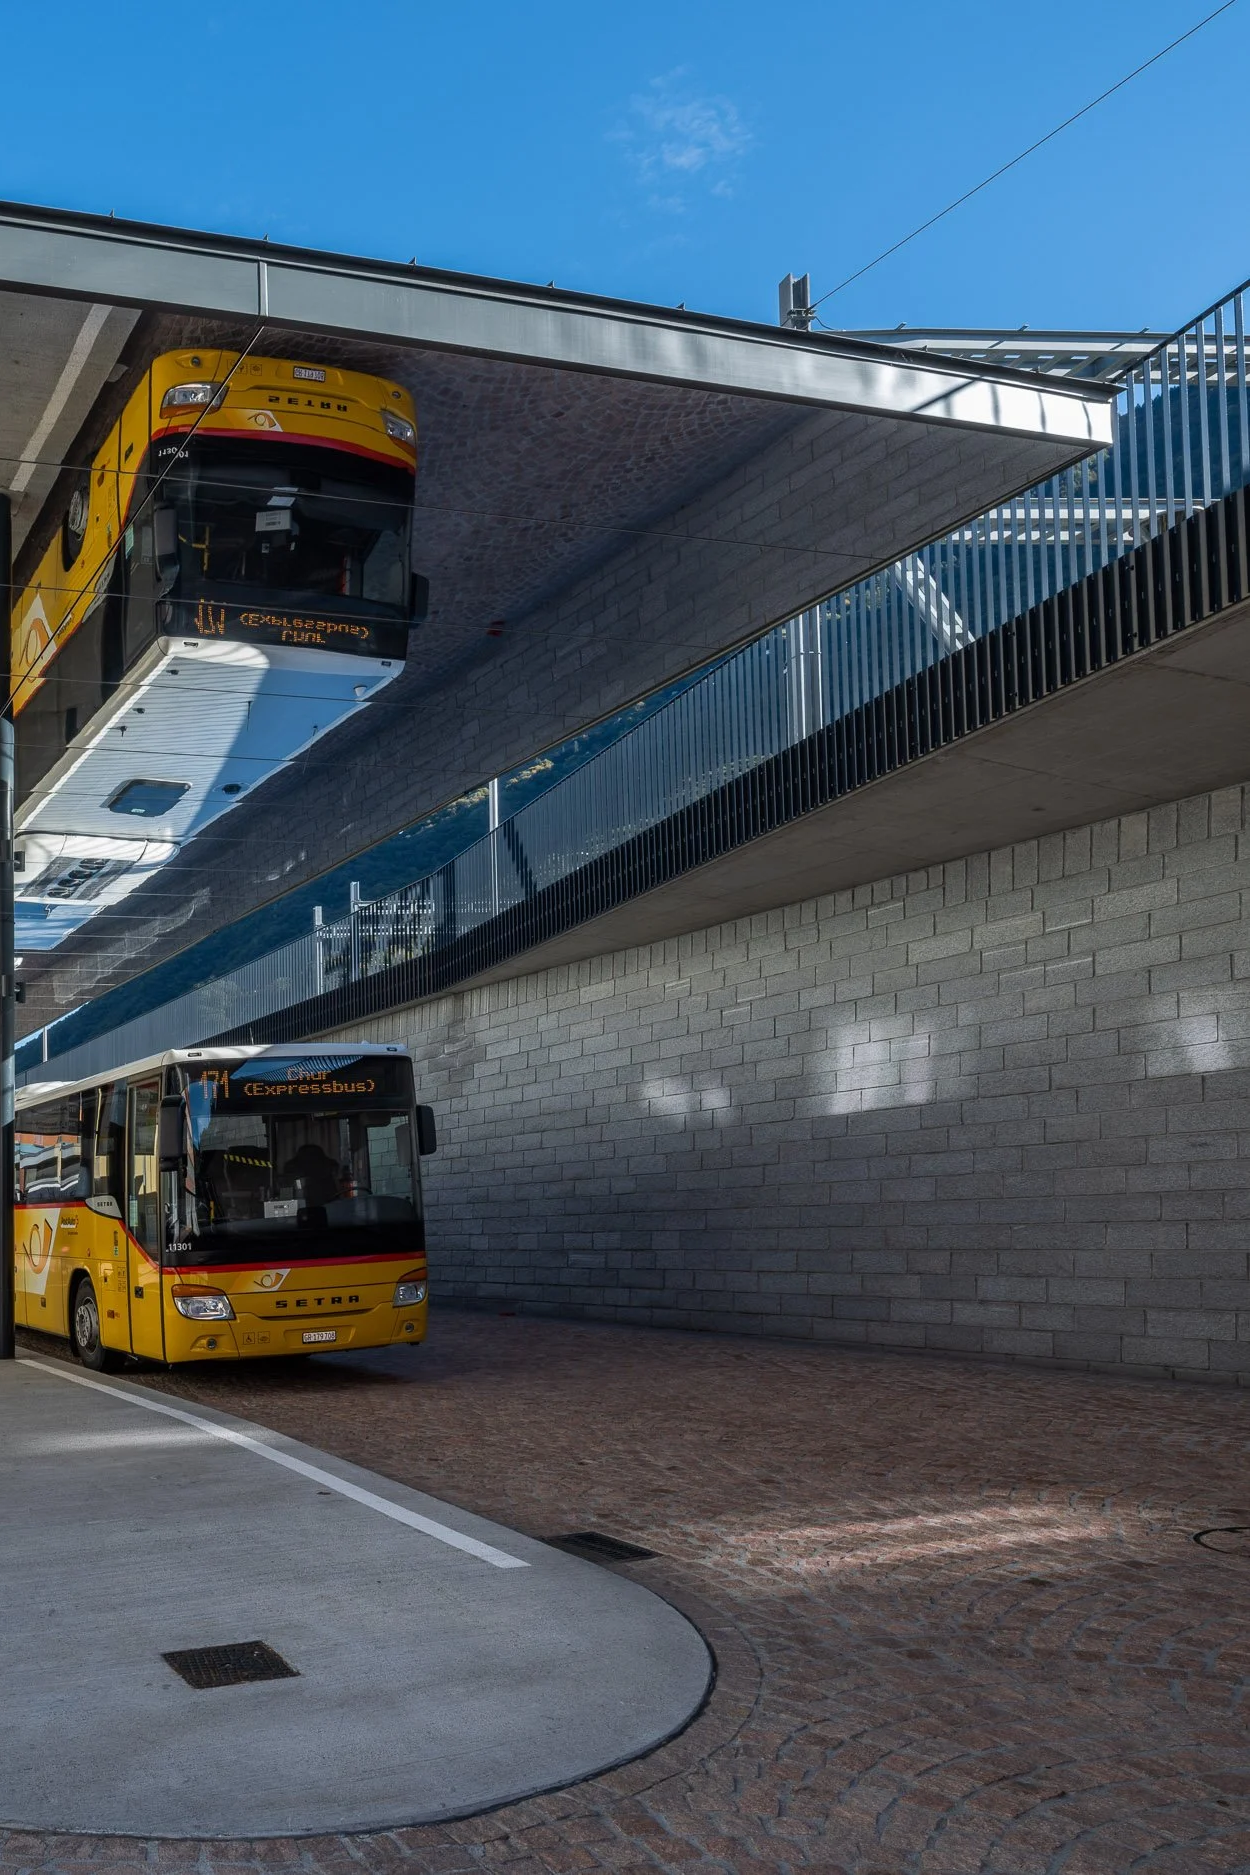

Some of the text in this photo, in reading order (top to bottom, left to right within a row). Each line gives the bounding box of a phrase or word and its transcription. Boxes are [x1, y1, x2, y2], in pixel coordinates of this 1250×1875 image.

[286, 1067, 332, 1081] Chur
[199, 1070, 230, 1099] 171
[243, 1079, 375, 1096] (Expressbus)
[168, 1242, 192, 1252] 11301
[275, 1295, 360, 1309] SETRA
